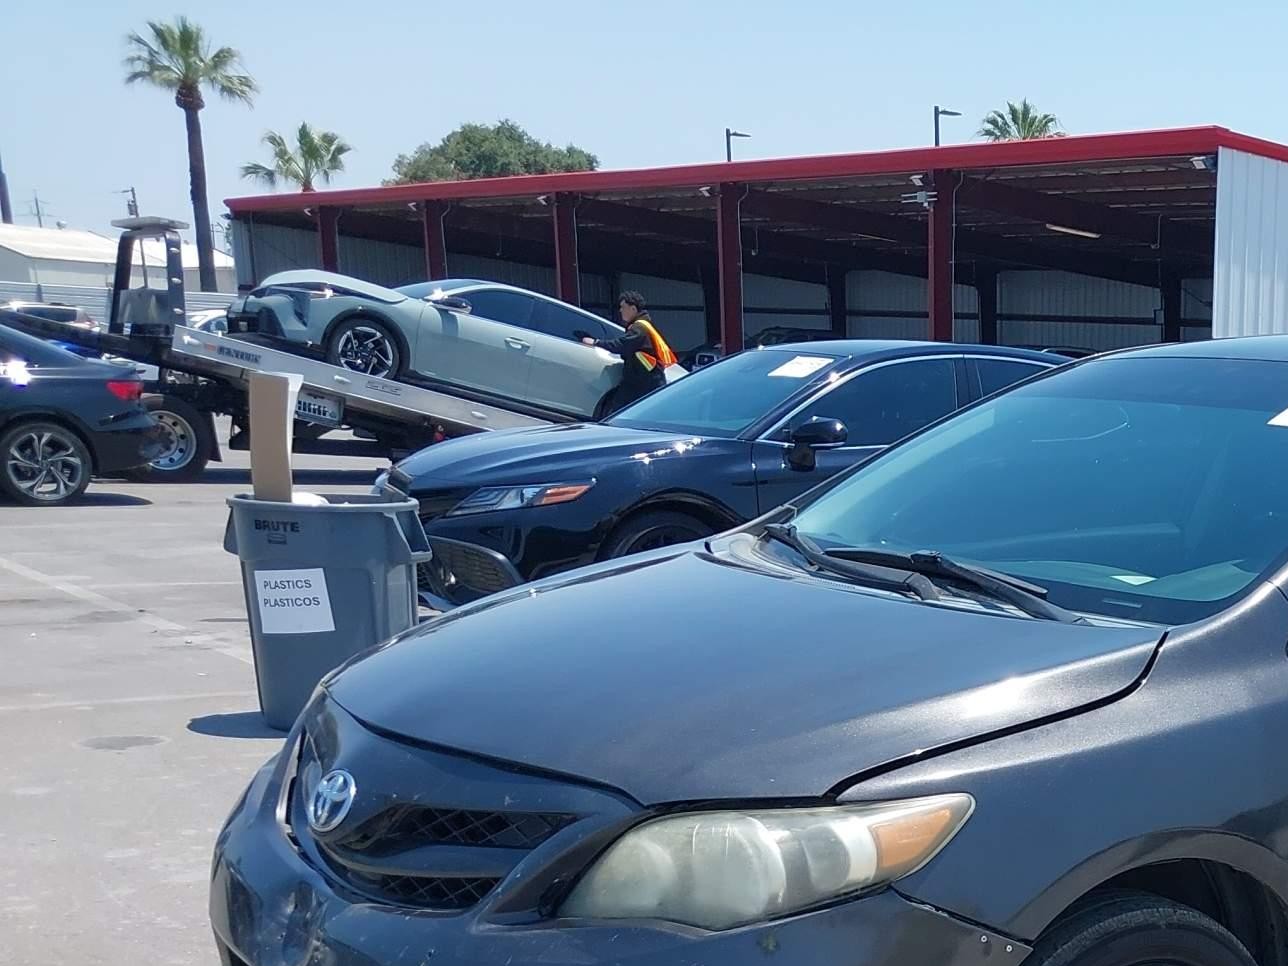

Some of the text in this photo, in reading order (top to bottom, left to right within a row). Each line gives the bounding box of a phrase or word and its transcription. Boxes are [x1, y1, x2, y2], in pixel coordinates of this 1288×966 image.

[254, 519, 300, 533] BRUTE
[263, 579, 313, 590] PLASTICS
[263, 596, 321, 608] PLASTICOS
